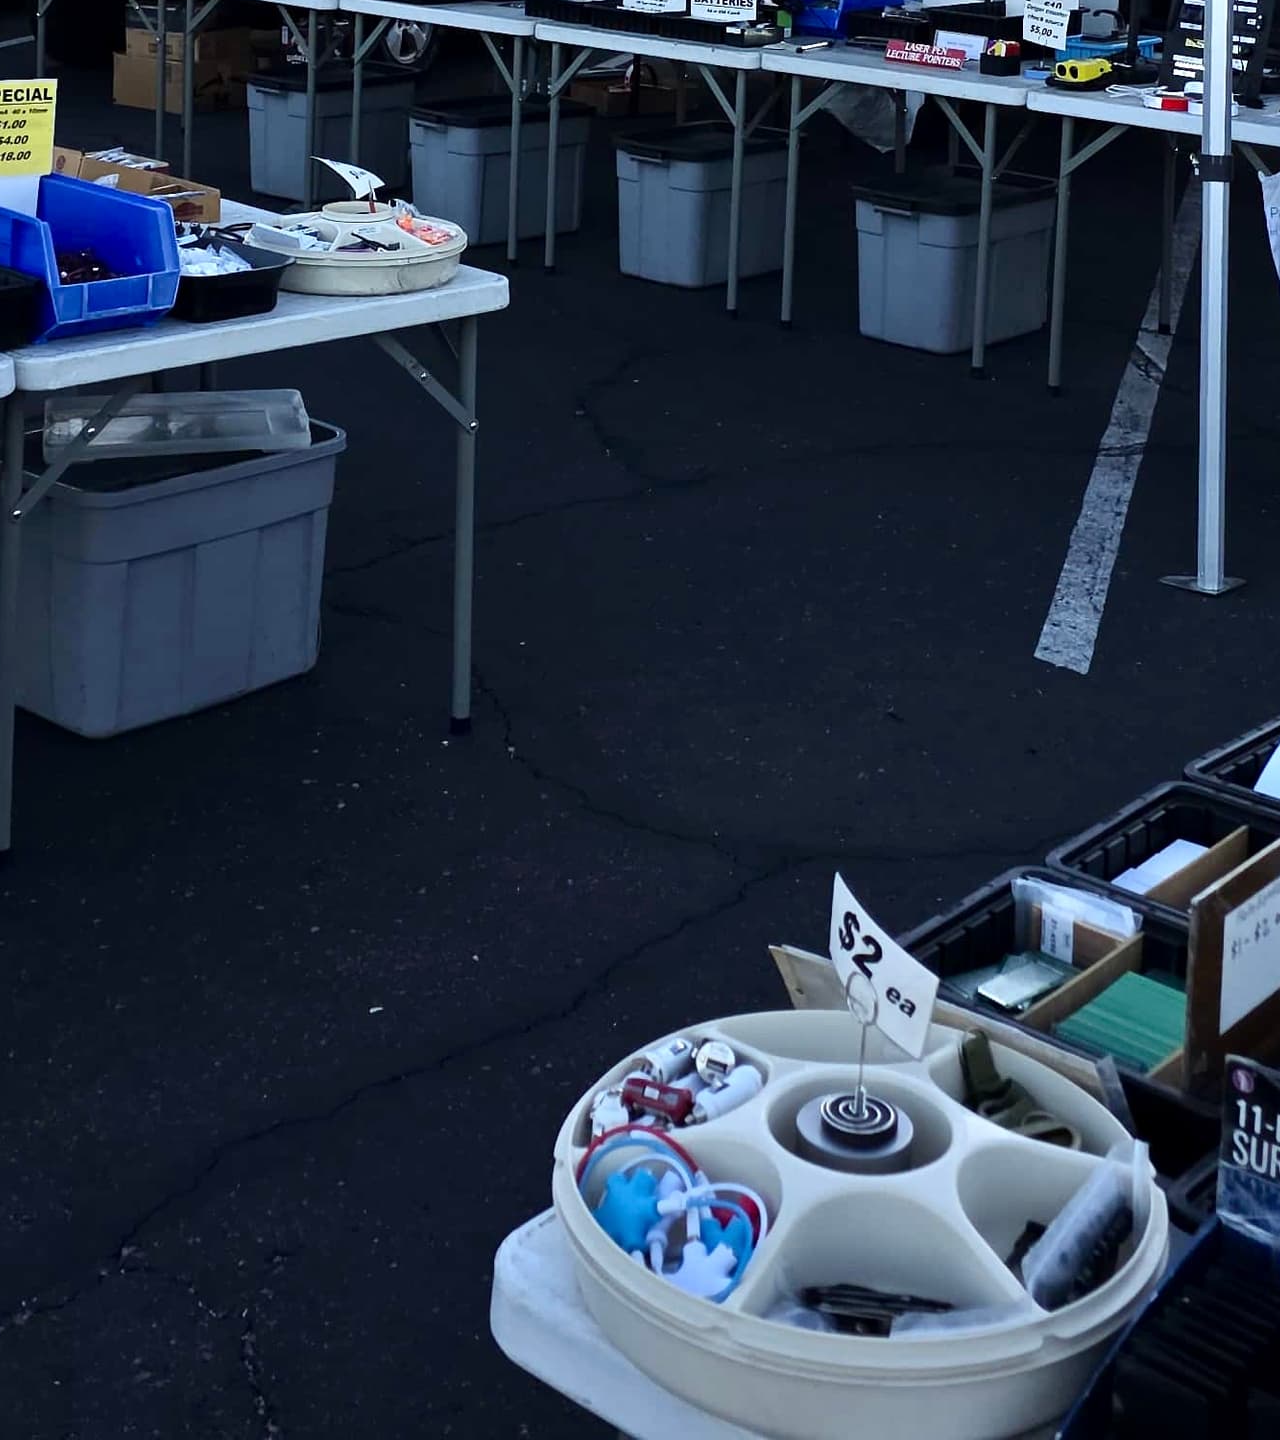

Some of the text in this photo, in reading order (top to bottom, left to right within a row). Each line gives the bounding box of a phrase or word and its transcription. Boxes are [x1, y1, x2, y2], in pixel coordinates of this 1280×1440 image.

[1030, 25, 1052, 37] $5.00
[905, 42, 947, 55] LASER PEN
[886, 49, 960, 67] LECTURE POINTERS
[838, 911, 917, 1018] $2 ea
